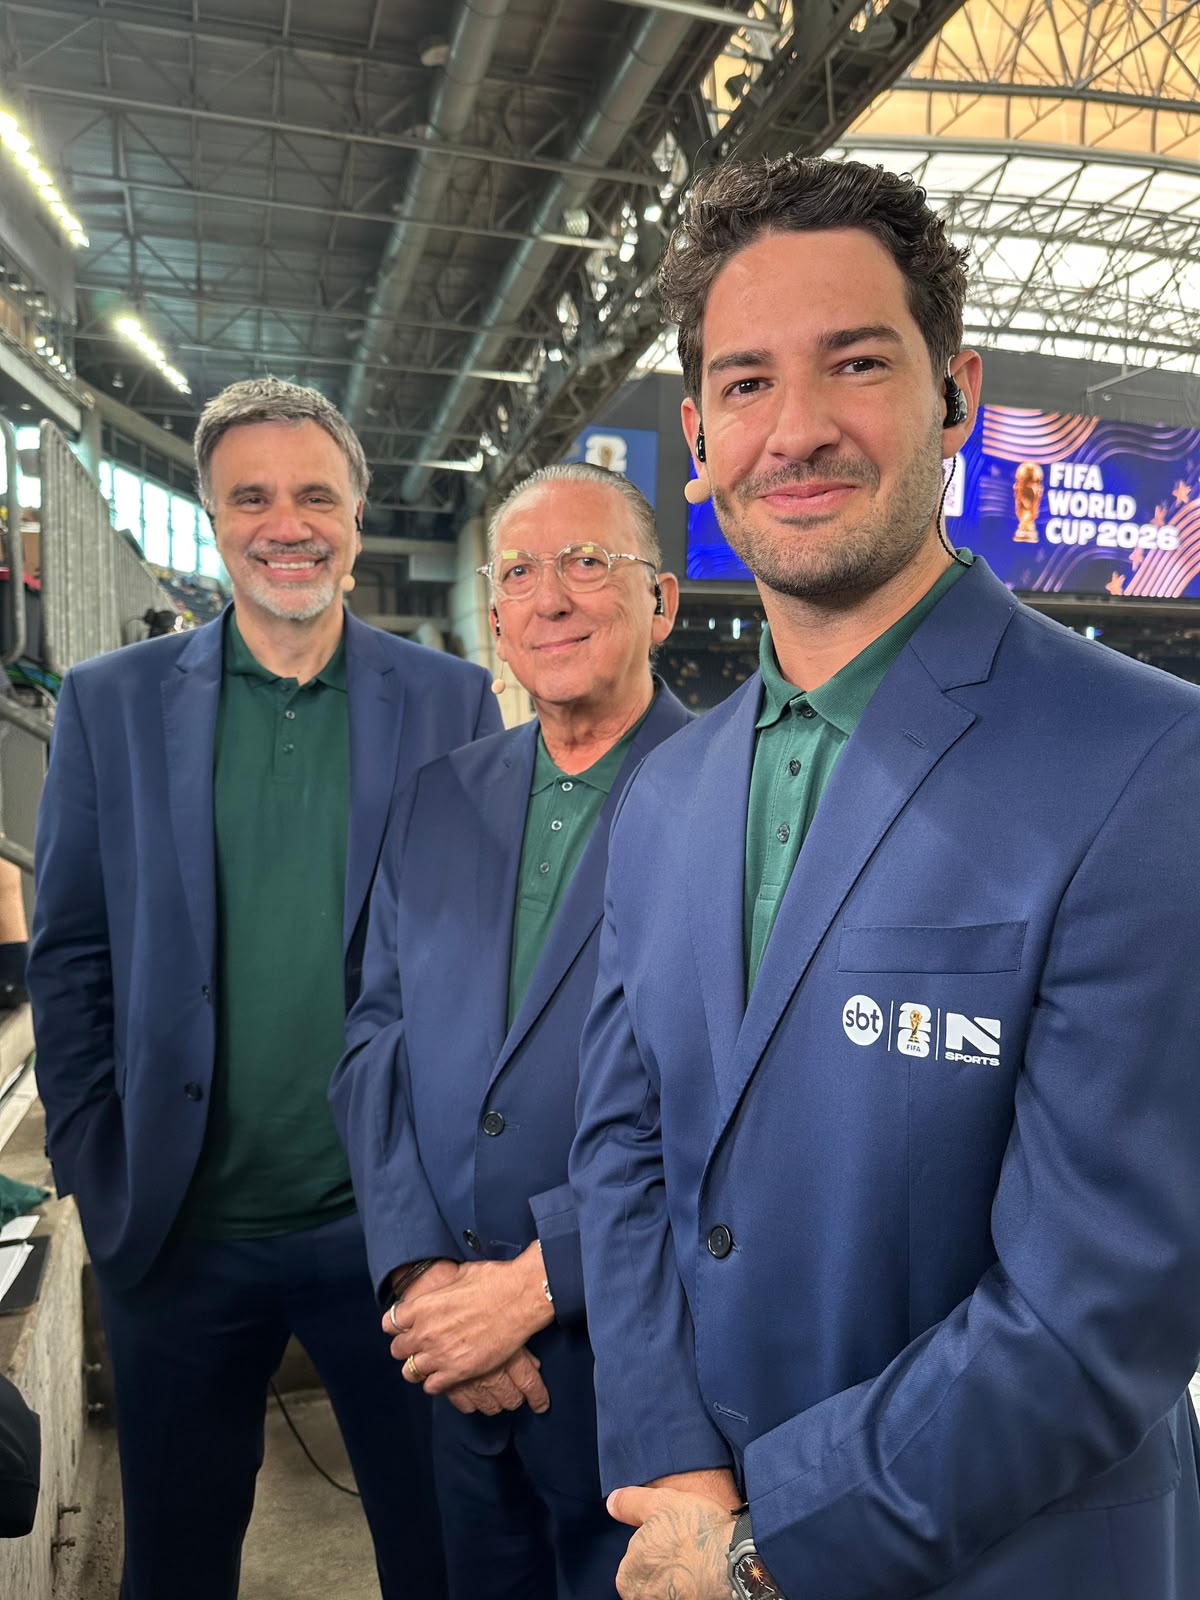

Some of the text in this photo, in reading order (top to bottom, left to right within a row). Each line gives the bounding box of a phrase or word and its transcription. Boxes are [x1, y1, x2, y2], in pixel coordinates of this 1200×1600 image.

[1050, 462, 1104, 491] FIFA
[1048, 490, 1137, 521] WORLD
[845, 1002, 880, 1034] sbt
[906, 1044, 921, 1052] FIFA
[945, 1051, 1000, 1066] SPORTS
